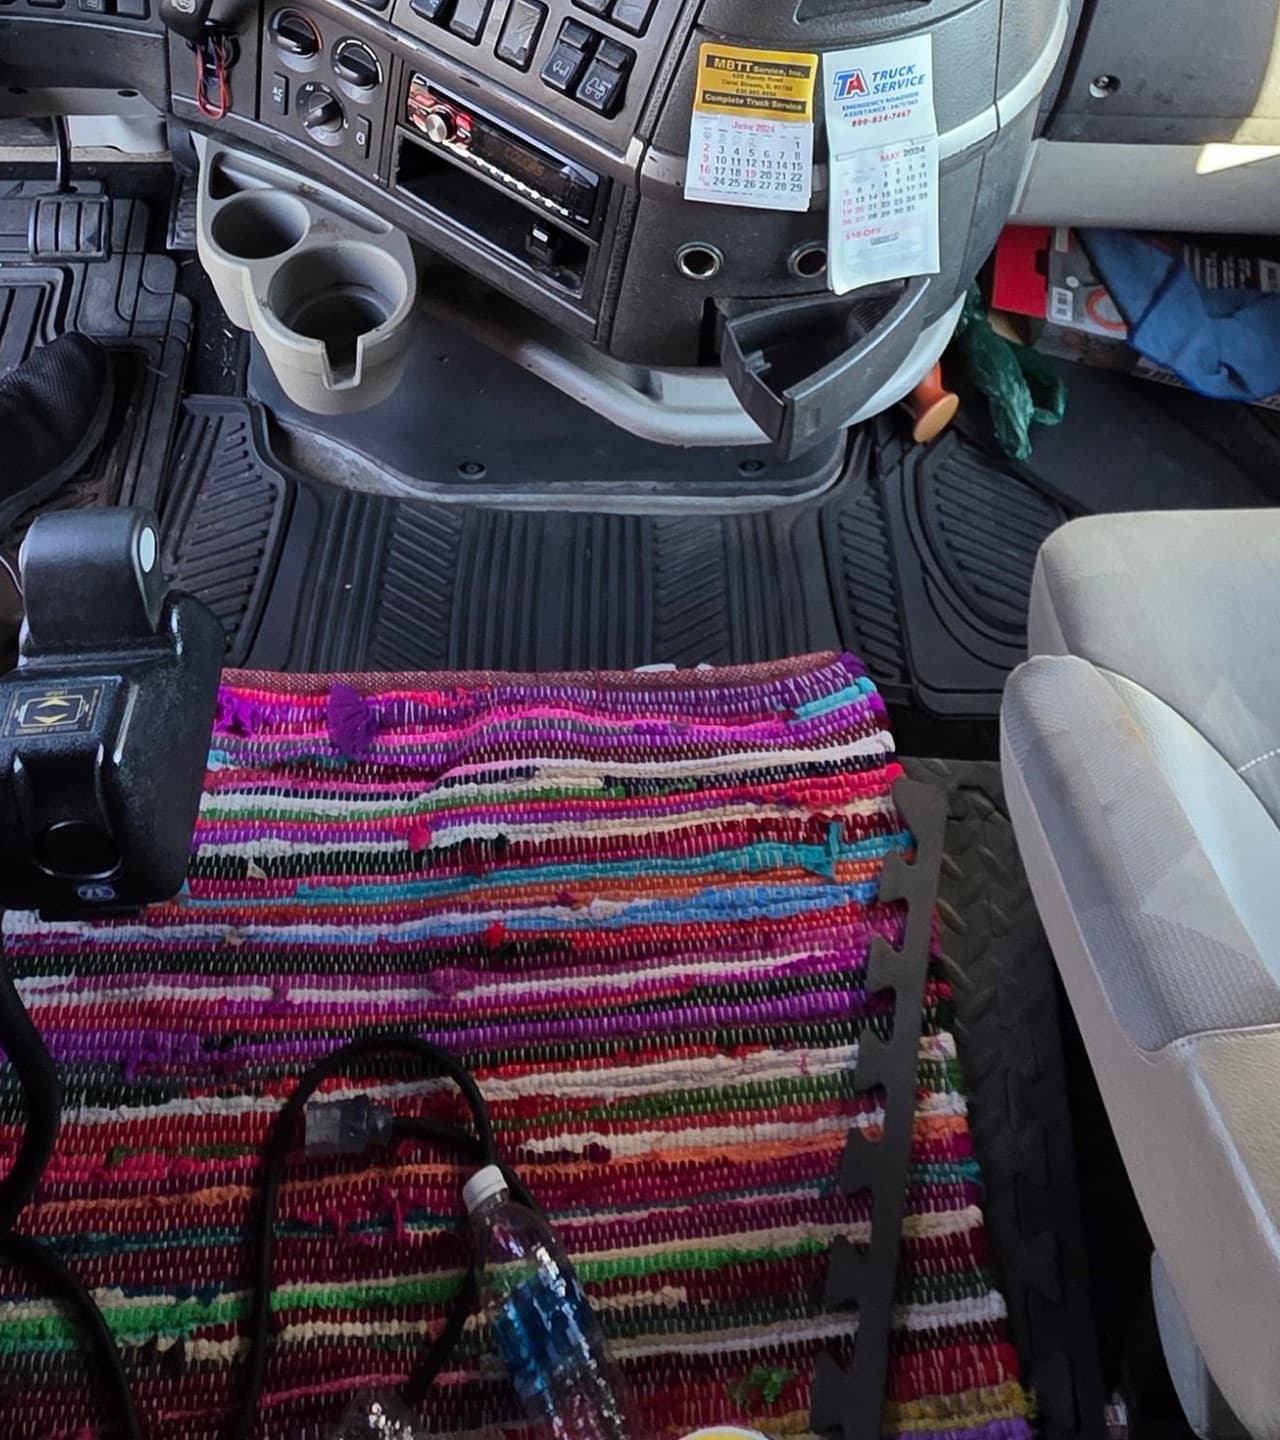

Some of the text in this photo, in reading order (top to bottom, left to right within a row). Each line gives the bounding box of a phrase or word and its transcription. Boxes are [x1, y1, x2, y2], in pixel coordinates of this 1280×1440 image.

[713, 57, 754, 73] MBTT
[871, 63, 916, 82] TRUCK
[835, 69, 868, 99] TA
[872, 74, 926, 95] SERVICE
[704, 92, 745, 105] Complete
[746, 97, 769, 108] Truck
[771, 101, 803, 111] Service
[732, 120, 754, 131] June
[880, 145, 925, 162] MAY 2024
[716, 155, 727, 165] 10
[731, 157, 741, 166] 11
[746, 158, 757, 167] 12
[761, 159, 772, 169] 13
[776, 161, 788, 170] 14
[791, 162, 803, 171] 15
[700, 164, 802, 182] 16 17 18 19 20 21 22
[712, 176, 725, 186] 24
[727, 178, 740, 187] 25
[743, 179, 756, 189] 26
[759, 180, 772, 190] 27
[774, 181, 787, 191] 28
[790, 183, 802, 192] 29
